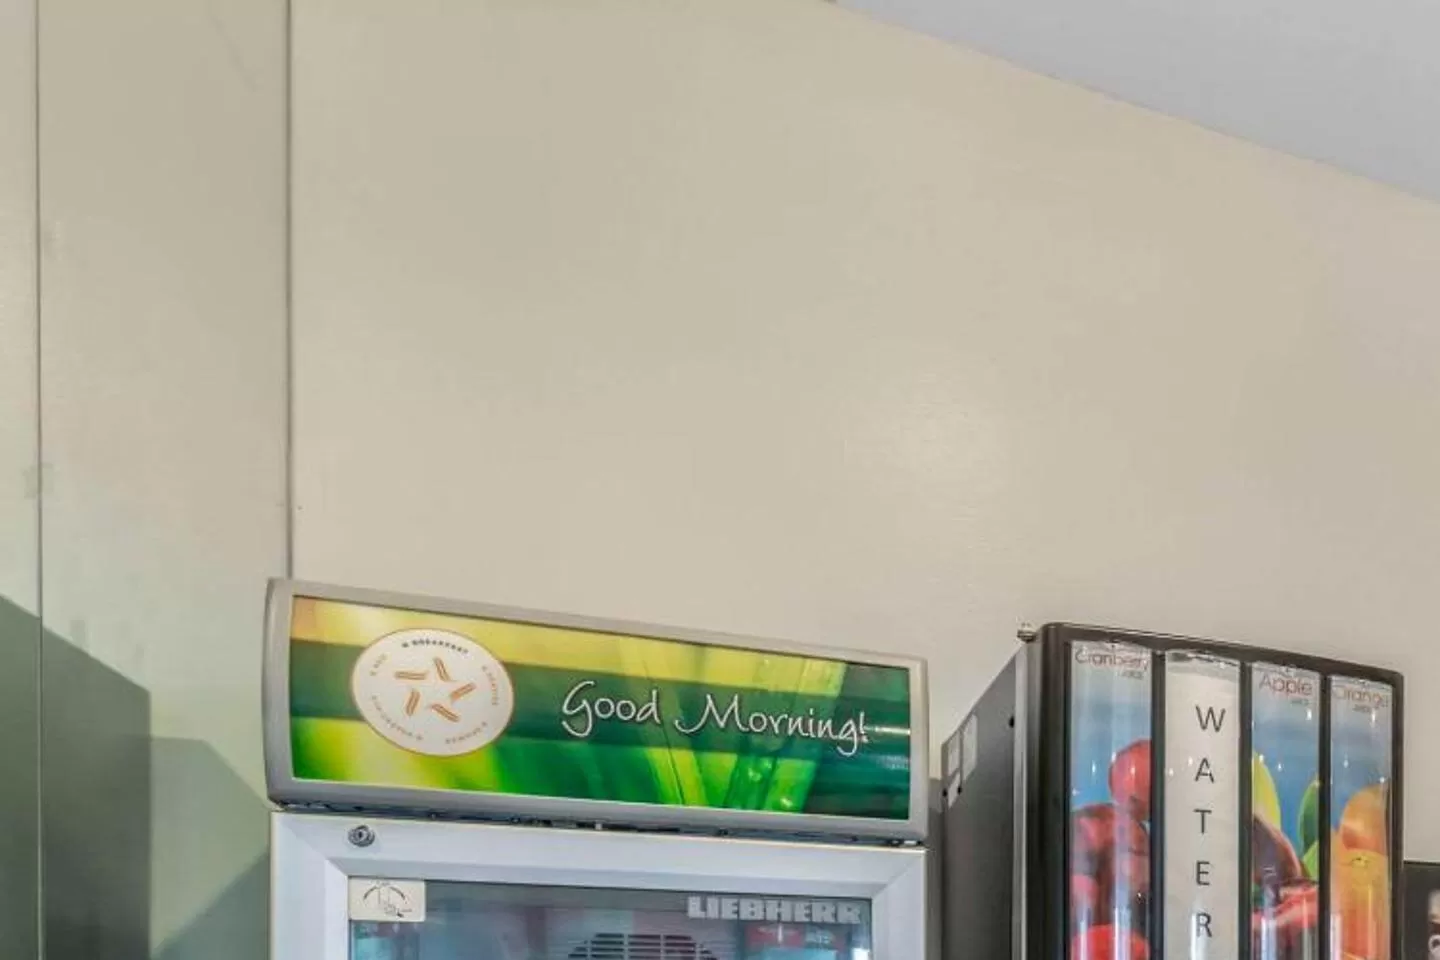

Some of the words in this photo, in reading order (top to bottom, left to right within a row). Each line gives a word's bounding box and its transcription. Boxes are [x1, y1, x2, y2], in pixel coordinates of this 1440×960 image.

[1259, 671, 1313, 697] Apple
[561, 680, 661, 738] Good
[674, 692, 869, 756] Morning!
[1193, 704, 1226, 938] WATER
[687, 895, 861, 924] LIEBHERR
